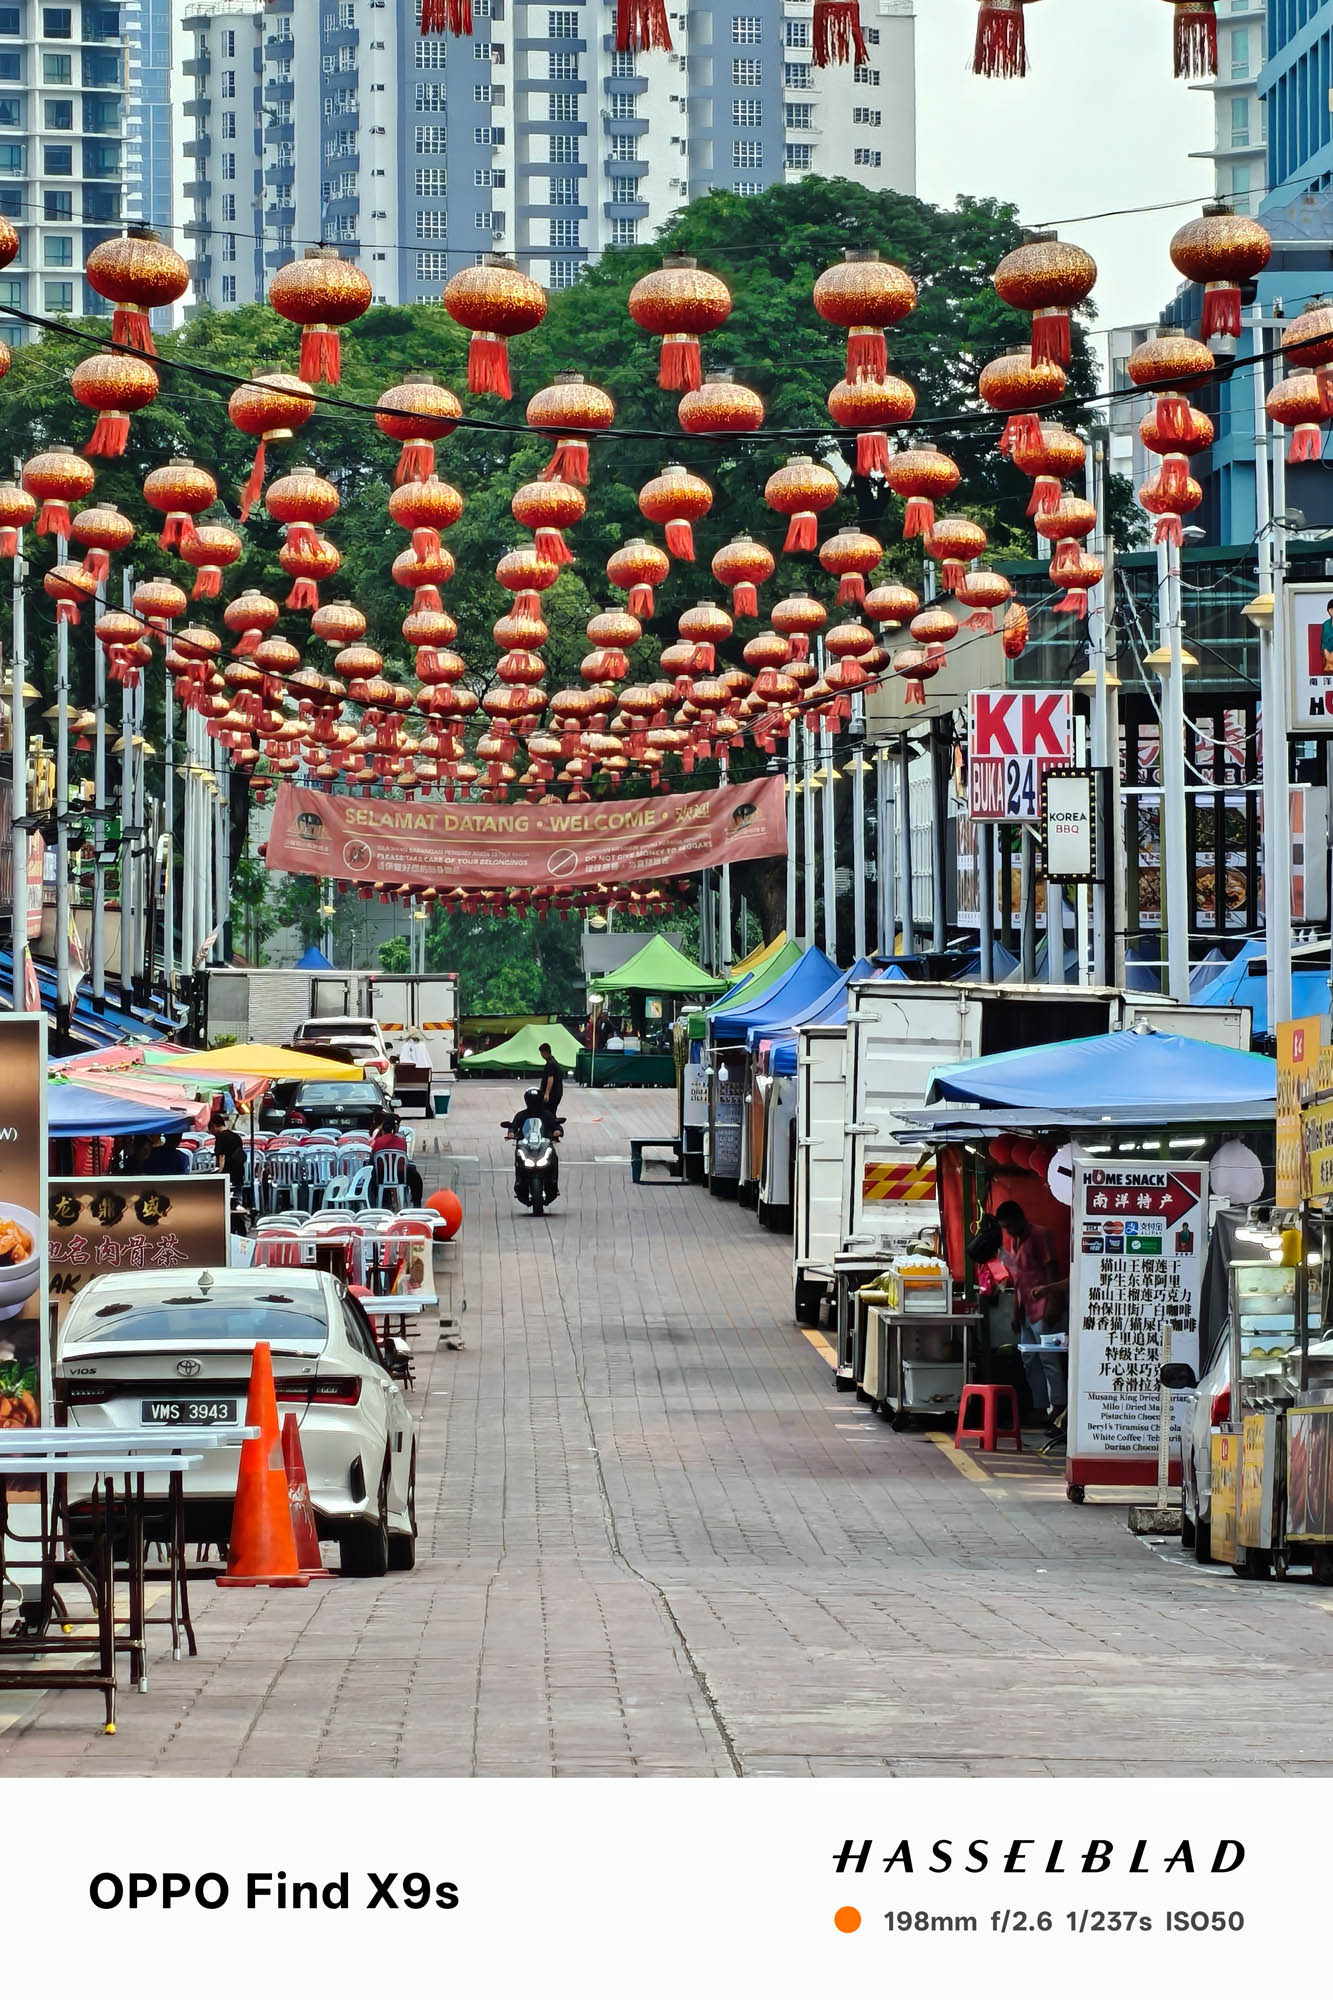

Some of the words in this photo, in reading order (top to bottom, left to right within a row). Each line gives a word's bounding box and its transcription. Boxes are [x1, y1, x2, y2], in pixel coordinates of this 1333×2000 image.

[977, 694, 1065, 755] KK
[973, 763, 1004, 812] BUKA
[1007, 759, 1036, 816] 24
[344, 808, 438, 830] SELAMAT
[444, 815, 529, 832] DATANG
[550, 810, 656, 833] WELCOME
[1050, 813, 1087, 822] KOREA
[1056, 825, 1079, 834] BBQ
[424, 856, 443, 864] CARE
[1083, 1169, 1123, 1185] HOME
[1125, 1174, 1165, 1186] SNACK
[1093, 1192, 1173, 1209] 南洋特产
[1100, 1273, 1180, 1289] 野生东革阿里
[1088, 1287, 1192, 1303] 猫山王榴莲巧克力
[1105, 1347, 1164, 1361] 特级芒果
[1088, 1393, 1118, 1403] Musang
[1120, 1393, 1137, 1403] King
[1139, 1392, 1160, 1401] Dried
[151, 1404, 180, 1418] VMS
[189, 1404, 228, 1419] 3943
[1126, 1403, 1147, 1411] Dried
[1149, 1403, 1174, 1412] Mao
[1101, 1412, 1136, 1421] Pistachio
[1088, 1422, 1113, 1433] Beryl's
[1115, 1423, 1149, 1432] Tiramisu
[1093, 1433, 1115, 1441] White
[1117, 1433, 1142, 1441] Coffee
[1105, 1443, 1131, 1451] Durian
